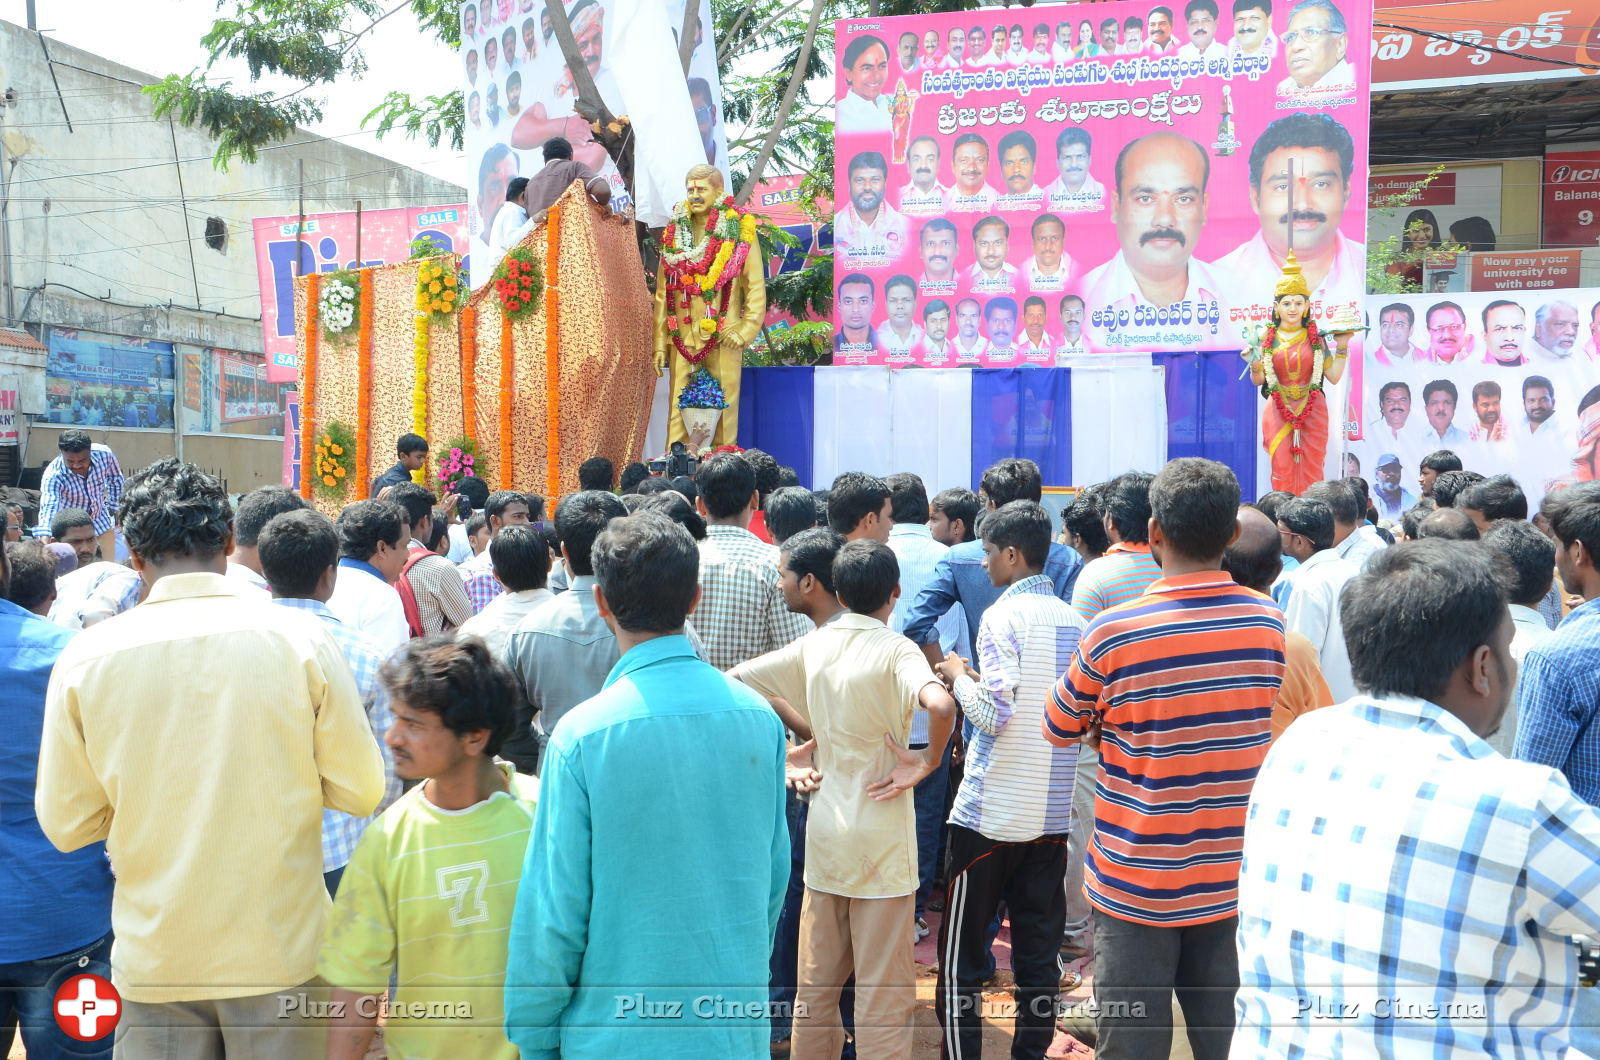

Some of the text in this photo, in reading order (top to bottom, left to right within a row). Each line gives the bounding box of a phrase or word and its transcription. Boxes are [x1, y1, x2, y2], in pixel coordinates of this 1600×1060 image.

[1424, 10, 1573, 65] బ్యాంక్
[1111, 59, 1137, 84] శుభ
[1208, 56, 1232, 79] అన్ని
[1232, 53, 1270, 80] వర్గాల
[937, 89, 1202, 135] ప్రజలకు శుభాకాంక్షలు
[420, 212, 453, 225] SALE
[1578, 210, 1593, 226] 9
[1483, 255, 1569, 268] Now pay your
[1483, 266, 1568, 279] university fee
[1495, 279, 1554, 289] with ease
[1197, 300, 1220, 335] రెడ్డి
[436, 860, 490, 928] 7
